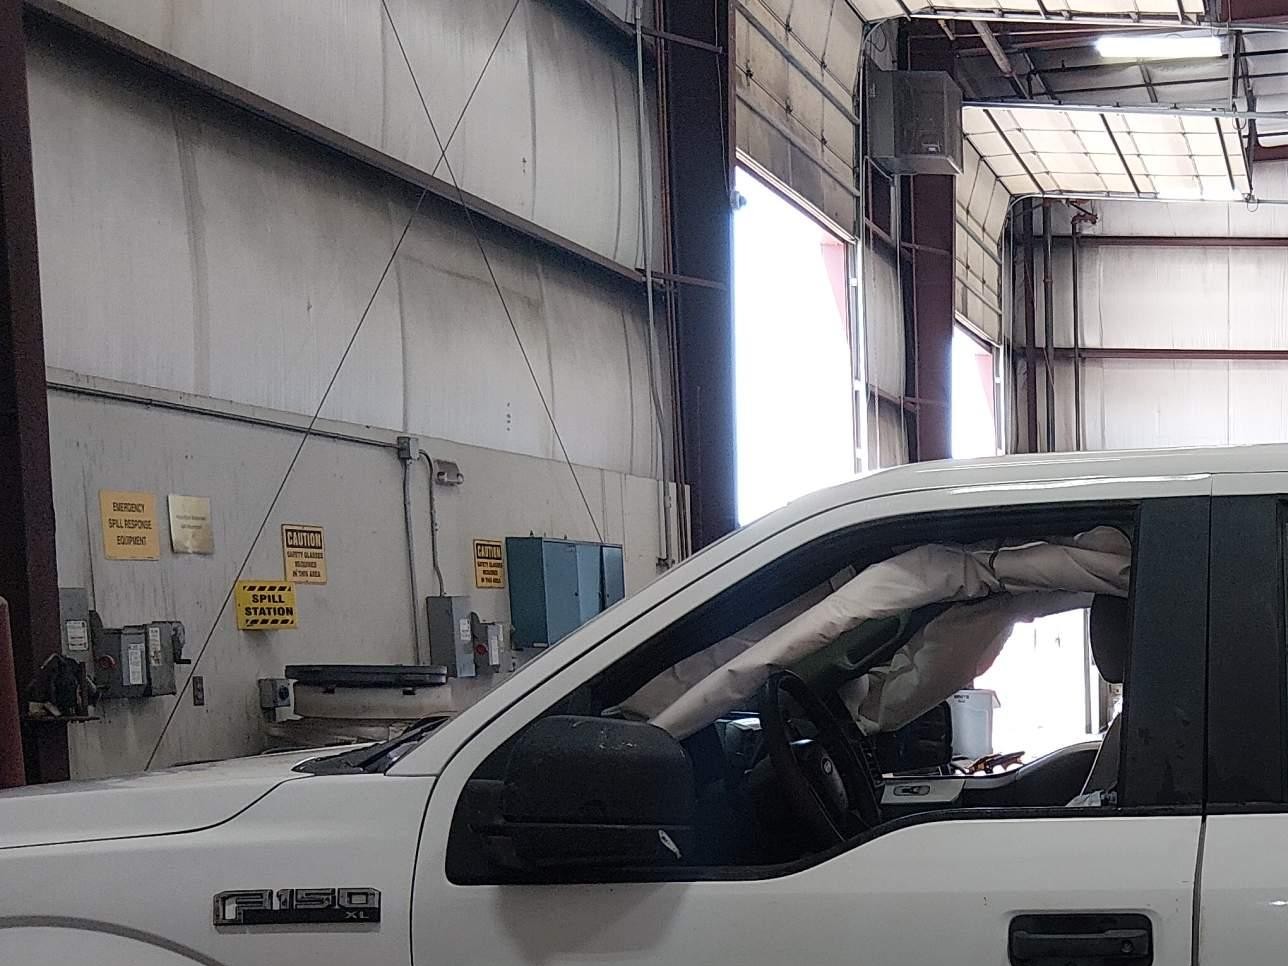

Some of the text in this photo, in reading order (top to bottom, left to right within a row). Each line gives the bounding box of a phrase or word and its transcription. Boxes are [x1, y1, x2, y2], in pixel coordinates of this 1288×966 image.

[112, 501, 145, 513] EMERGENCY
[108, 518, 152, 530] SPILL RESPONSE
[116, 535, 147, 546] EQUIPMENT
[287, 531, 322, 548] CAUTION
[477, 544, 502, 559] CAUTION
[251, 593, 286, 604] SPILL
[244, 606, 294, 617] STATION
[345, 910, 370, 919] XL
